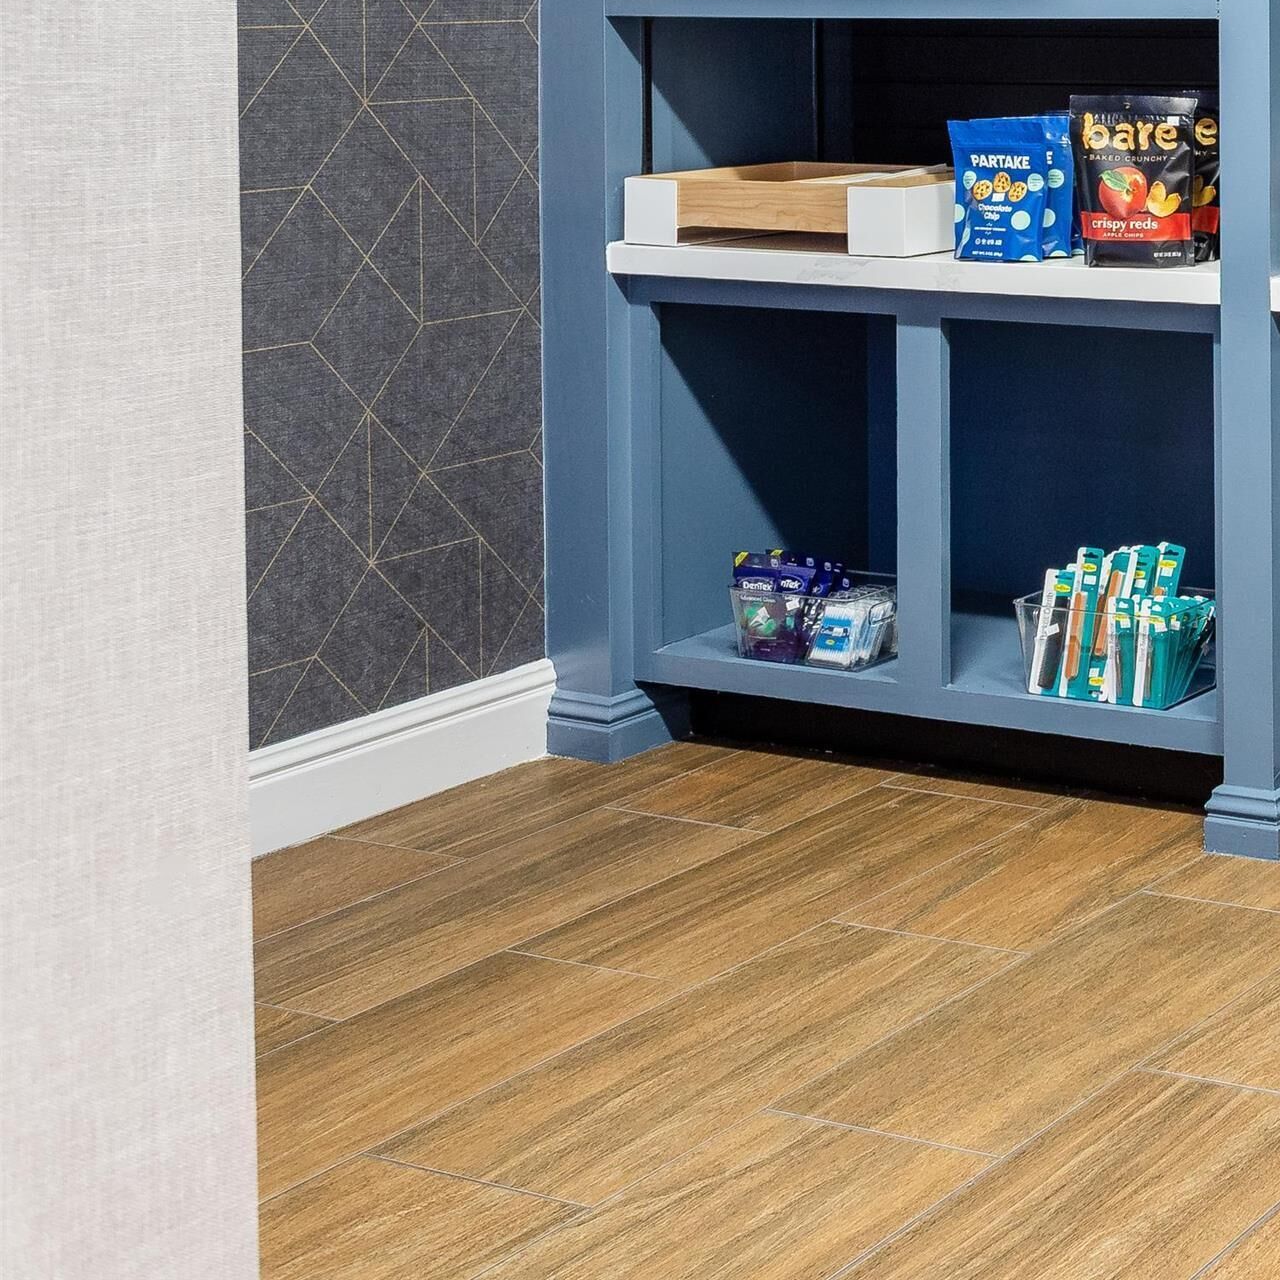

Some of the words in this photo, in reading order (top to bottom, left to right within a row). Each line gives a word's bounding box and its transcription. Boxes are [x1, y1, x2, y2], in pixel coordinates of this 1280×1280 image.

[1082, 112, 1178, 151] bare
[970, 154, 1031, 169] PARTAKE
[1089, 154, 1121, 162] BAKED
[1092, 220, 1127, 233] crispy
[1129, 219, 1158, 230] reds
[742, 581, 773, 591] DenTek
